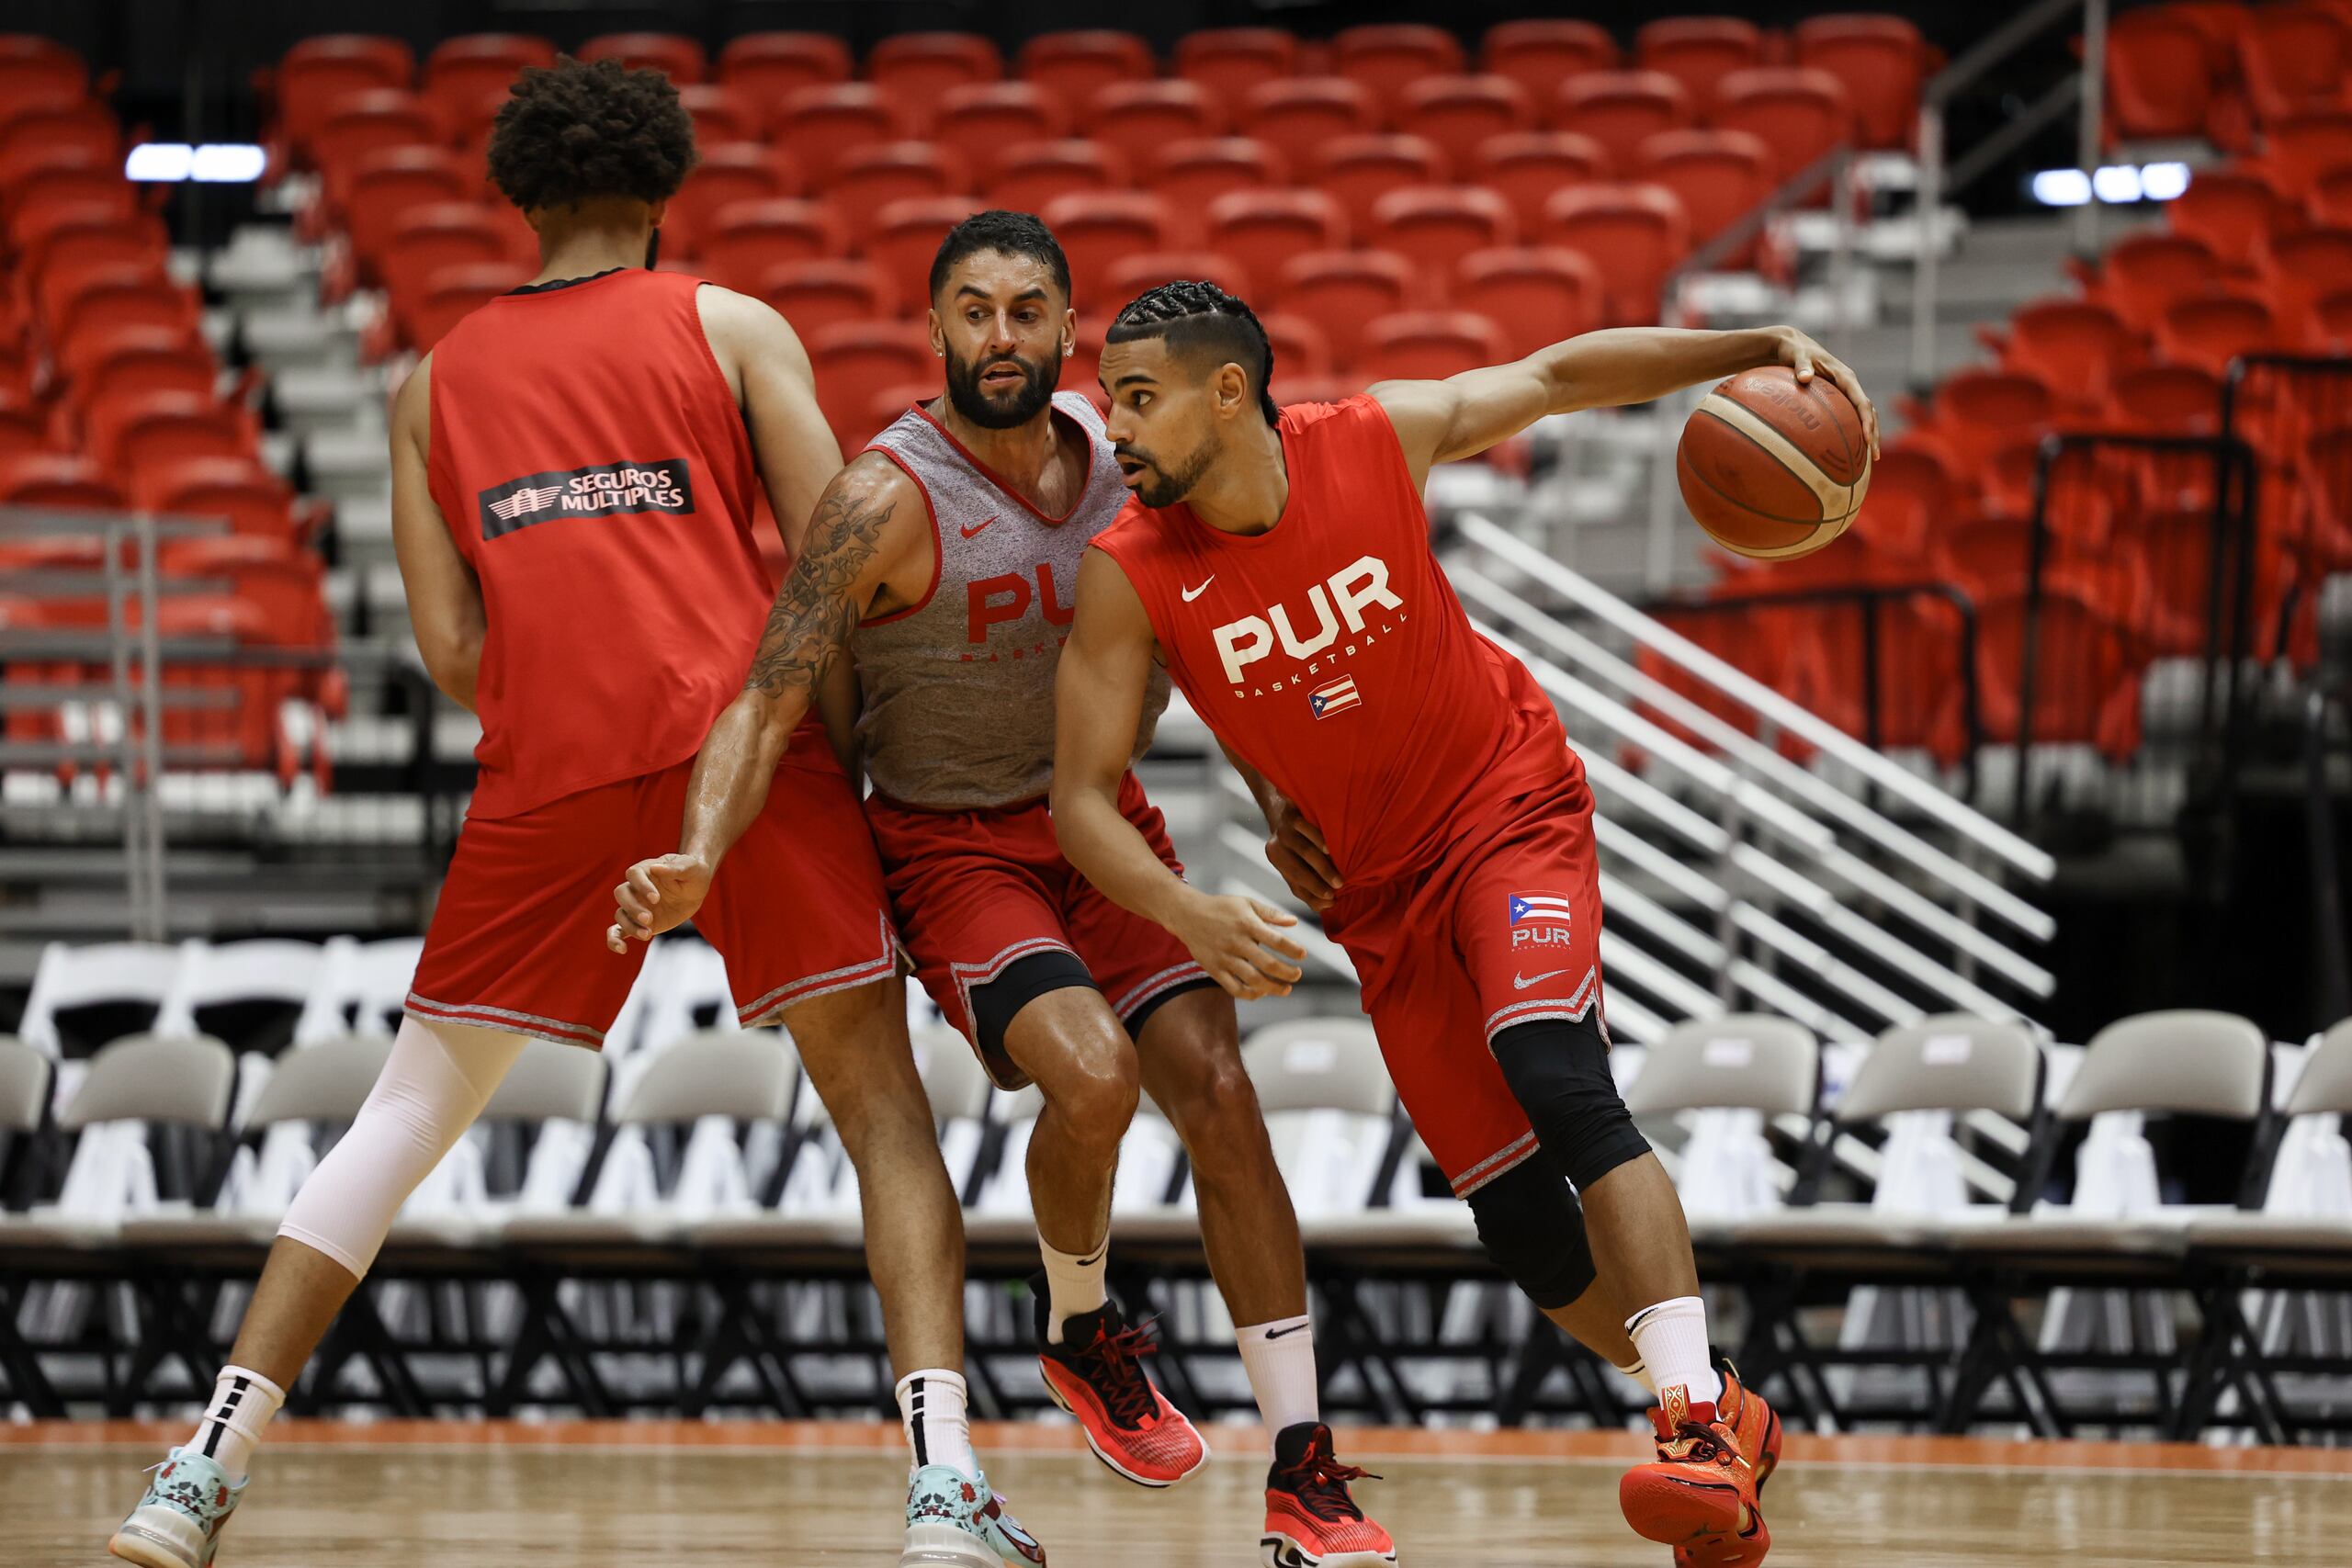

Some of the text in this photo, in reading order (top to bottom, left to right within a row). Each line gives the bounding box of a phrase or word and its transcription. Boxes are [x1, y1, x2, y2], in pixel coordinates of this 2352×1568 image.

[561, 488, 684, 511] MULTIPLES
[569, 468, 672, 495] SEGUROS
[967, 562, 1075, 644] PU
[1212, 555, 1404, 684] PUR
[1235, 613, 1408, 699] BASKETBALL
[1512, 927, 1571, 947] PUR
